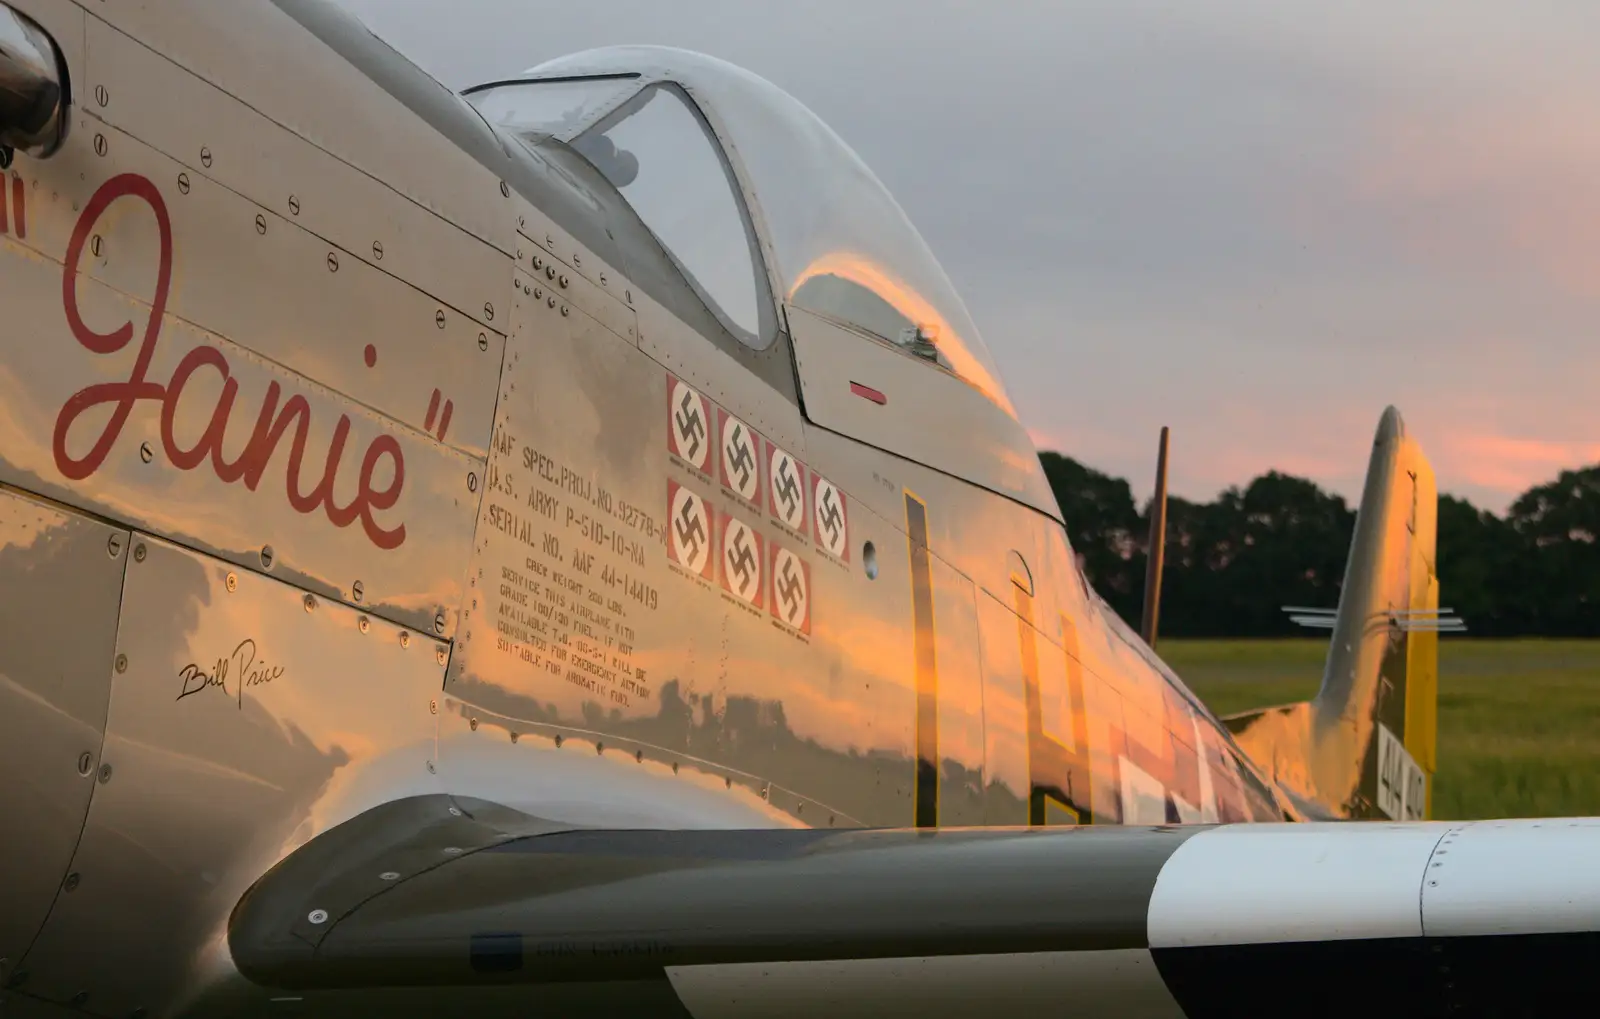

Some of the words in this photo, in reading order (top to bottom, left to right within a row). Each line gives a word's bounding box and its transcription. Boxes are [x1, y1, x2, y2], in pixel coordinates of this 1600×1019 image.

[492, 428, 517, 458] AAF
[489, 463, 518, 500] U.S.
[528, 486, 559, 521] ARMY
[566, 506, 645, 568] P-51D-10-NA
[489, 503, 535, 549] SERIAL
[543, 533, 564, 562] NO.
[572, 548, 595, 576] AAF
[601, 563, 659, 611] 44-14419
[526, 557, 549, 578] CREW
[552, 570, 584, 596] WEIGHT
[607, 597, 627, 618] LBS.
[500, 583, 528, 608] GRADE
[533, 600, 569, 628] 100/130
[573, 618, 598, 641] FUEL.
[604, 634, 614, 649] IF
[617, 640, 633, 657] NOT
[501, 566, 541, 596] SERVICE
[545, 587, 566, 608] THIS
[569, 600, 611, 630] AIRPLANE
[614, 622, 635, 642] WITH
[497, 620, 547, 652] CONSULTED
[551, 644, 568, 662] FOR
[571, 653, 617, 684] EMERGENCY
[620, 677, 651, 701] ACTION
[497, 637, 541, 668] SUITABLE
[545, 660, 561, 677] FOR
[565, 669, 606, 698] AROMATIC
[498, 601, 549, 636] AVAILABLE
[612, 656, 632, 676] WILL
[635, 667, 647, 683] BE
[176, 658, 228, 702] Bill
